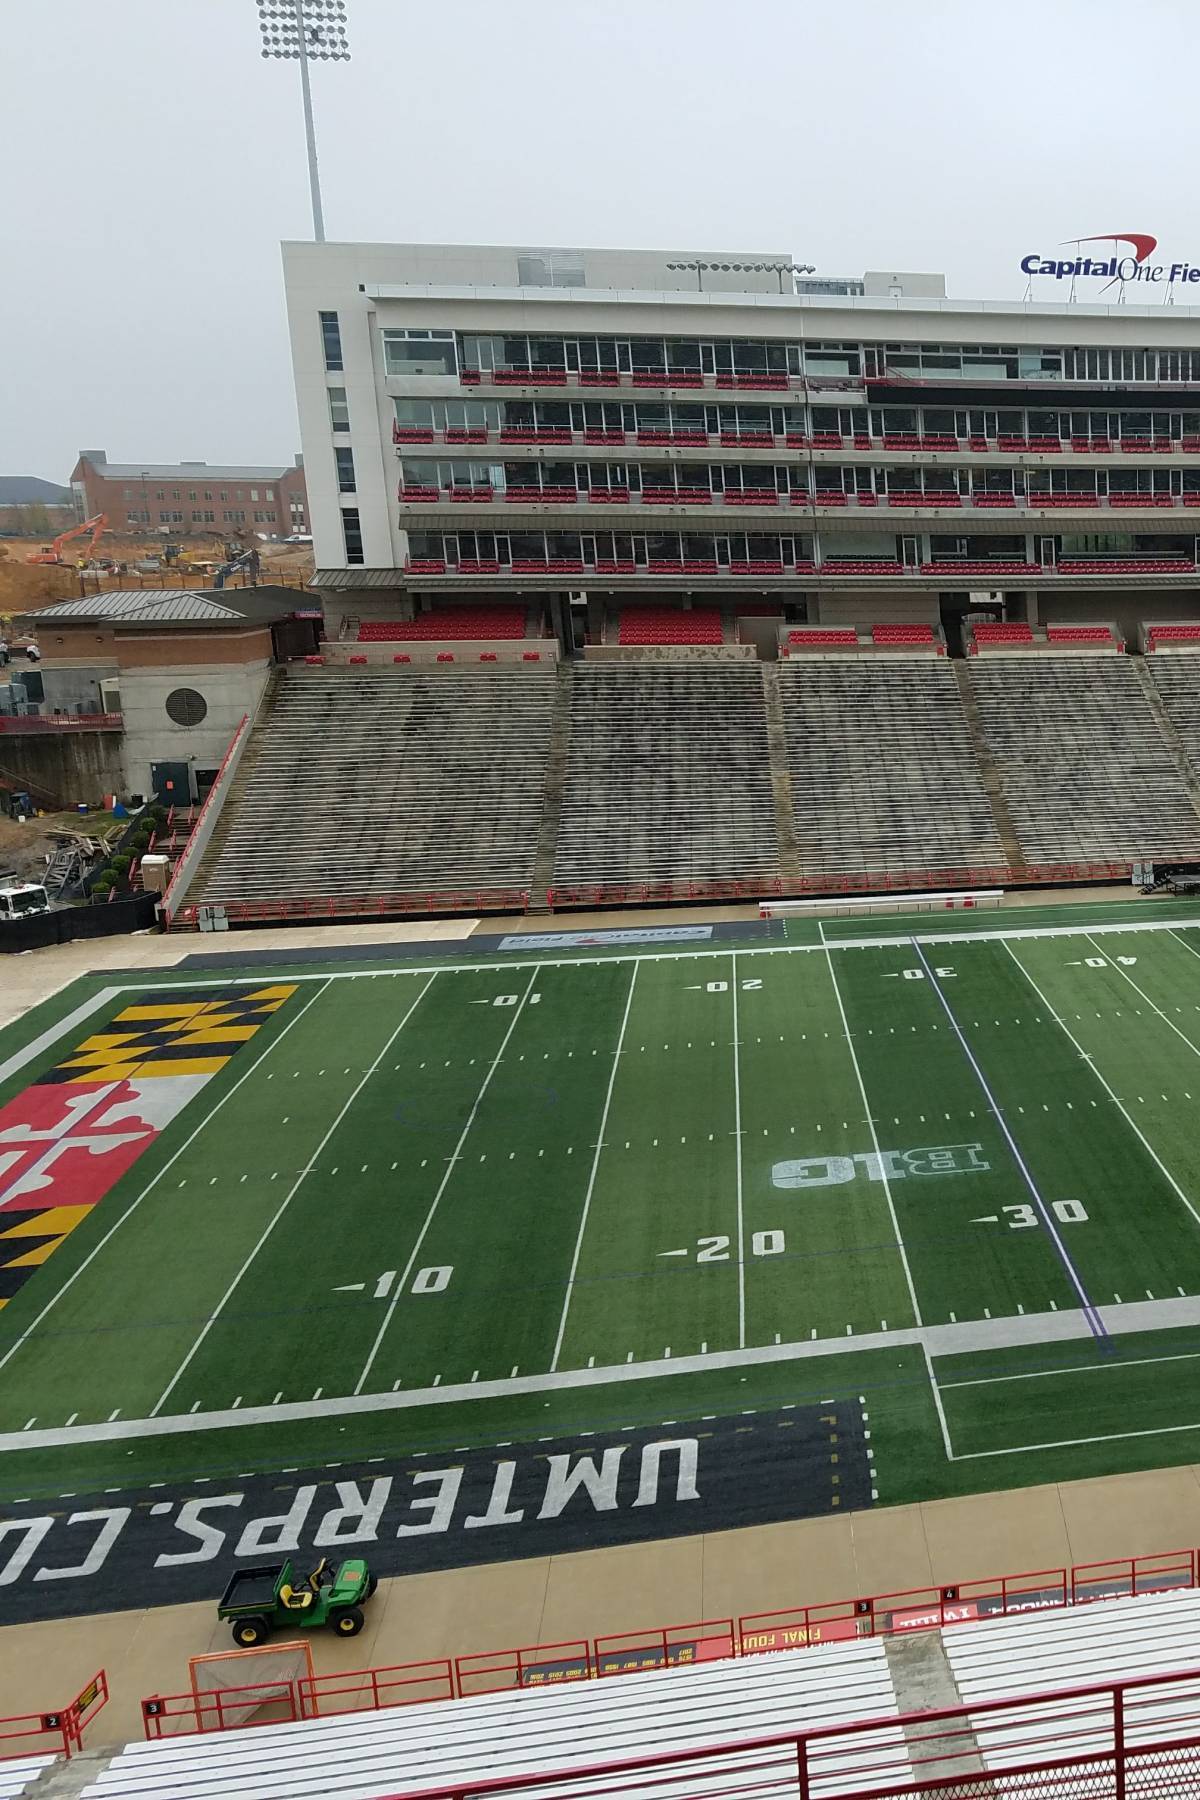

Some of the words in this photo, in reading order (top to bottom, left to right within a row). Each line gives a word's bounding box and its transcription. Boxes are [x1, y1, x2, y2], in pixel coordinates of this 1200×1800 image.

[1084, 956, 1138, 968] 40
[902, 967, 958, 980] 30
[706, 979, 763, 992] 20
[492, 993, 541, 1006] 10
[1002, 1200, 1089, 1229] 30
[695, 1230, 786, 1263] 20
[373, 1265, 455, 1298] 10
[860, 1602, 868, 1612] 3
[782, 1628, 821, 1644] FINAL
[149, 1704, 157, 1713] 3
[49, 1717, 57, 1726] 2
